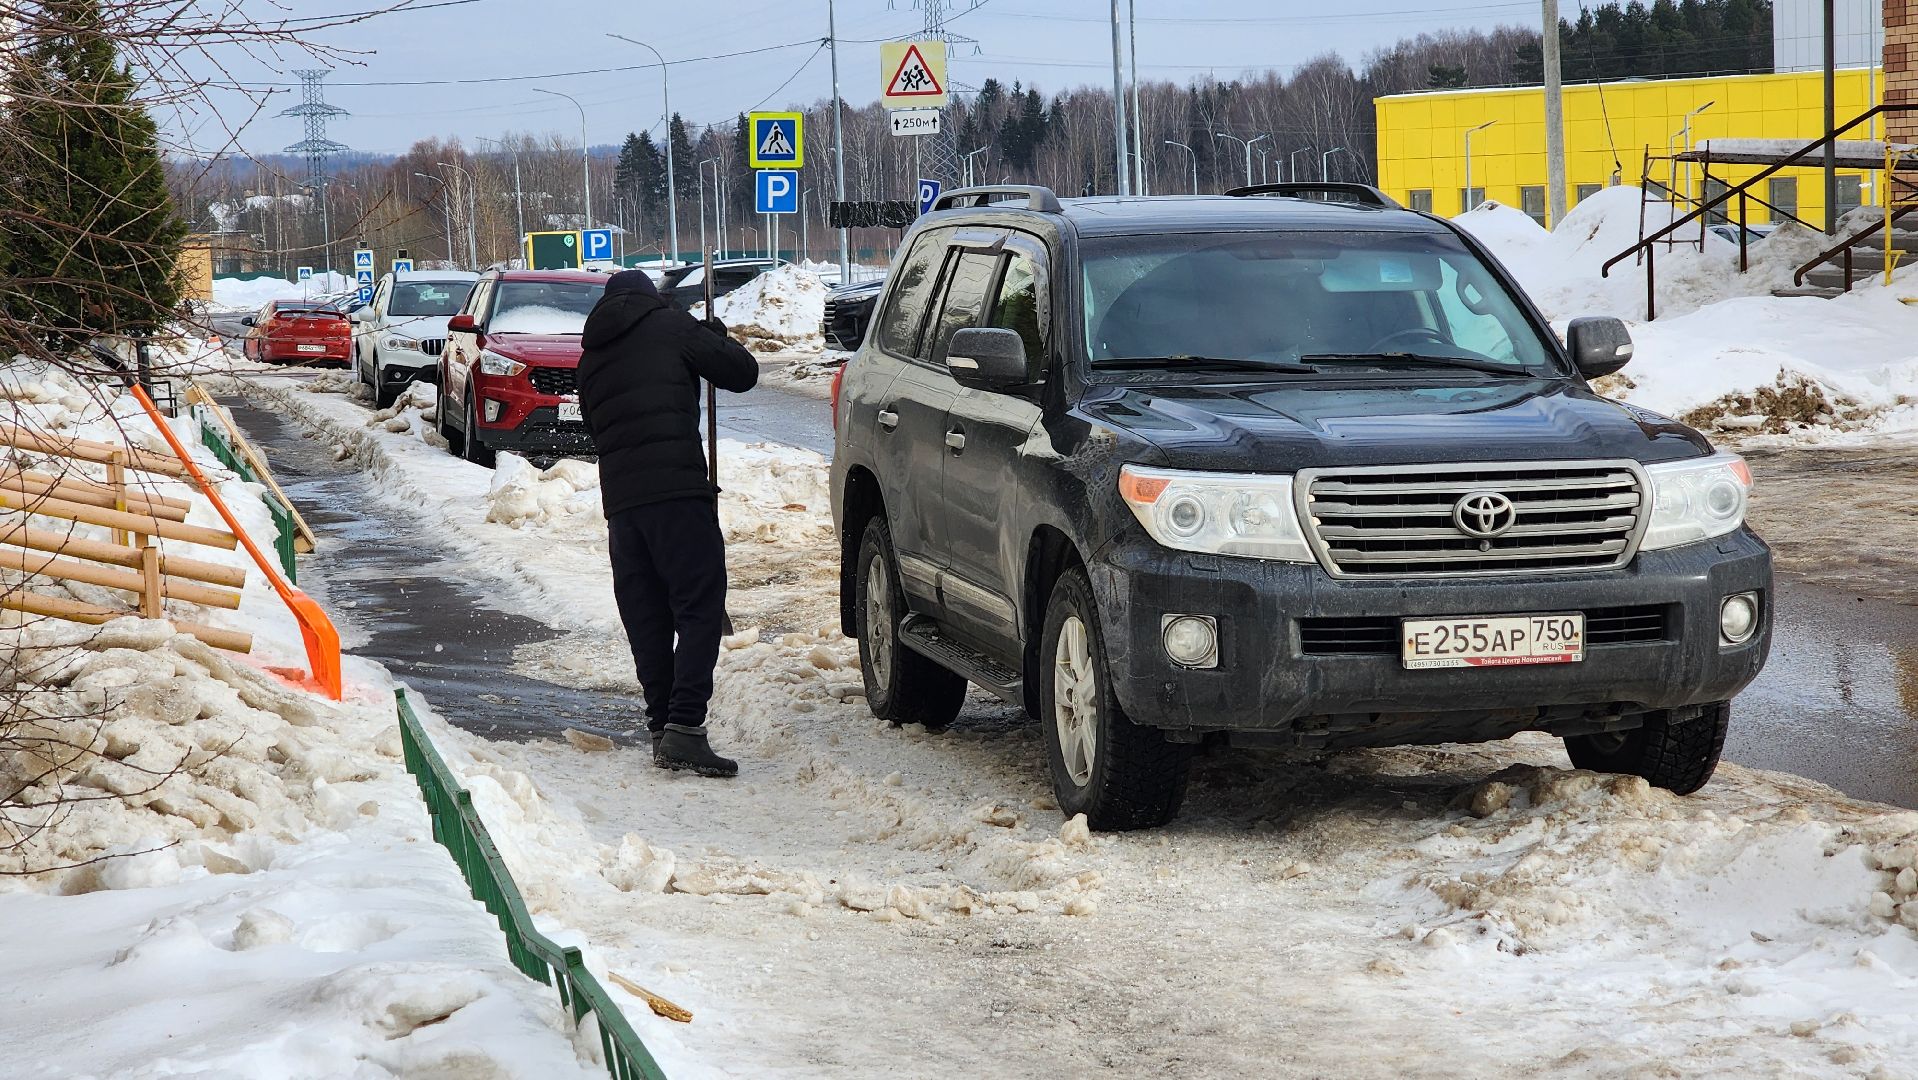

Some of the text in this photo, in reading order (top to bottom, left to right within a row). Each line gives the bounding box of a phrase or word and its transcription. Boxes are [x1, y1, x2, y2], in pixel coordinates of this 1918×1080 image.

[903, 117, 930, 129] 250м
[767, 175, 790, 209] P
[590, 233, 607, 257] P
[362, 289, 371, 299] P
[1414, 619, 1575, 655] Е255АР 750
[1543, 642, 1564, 651] RUS
